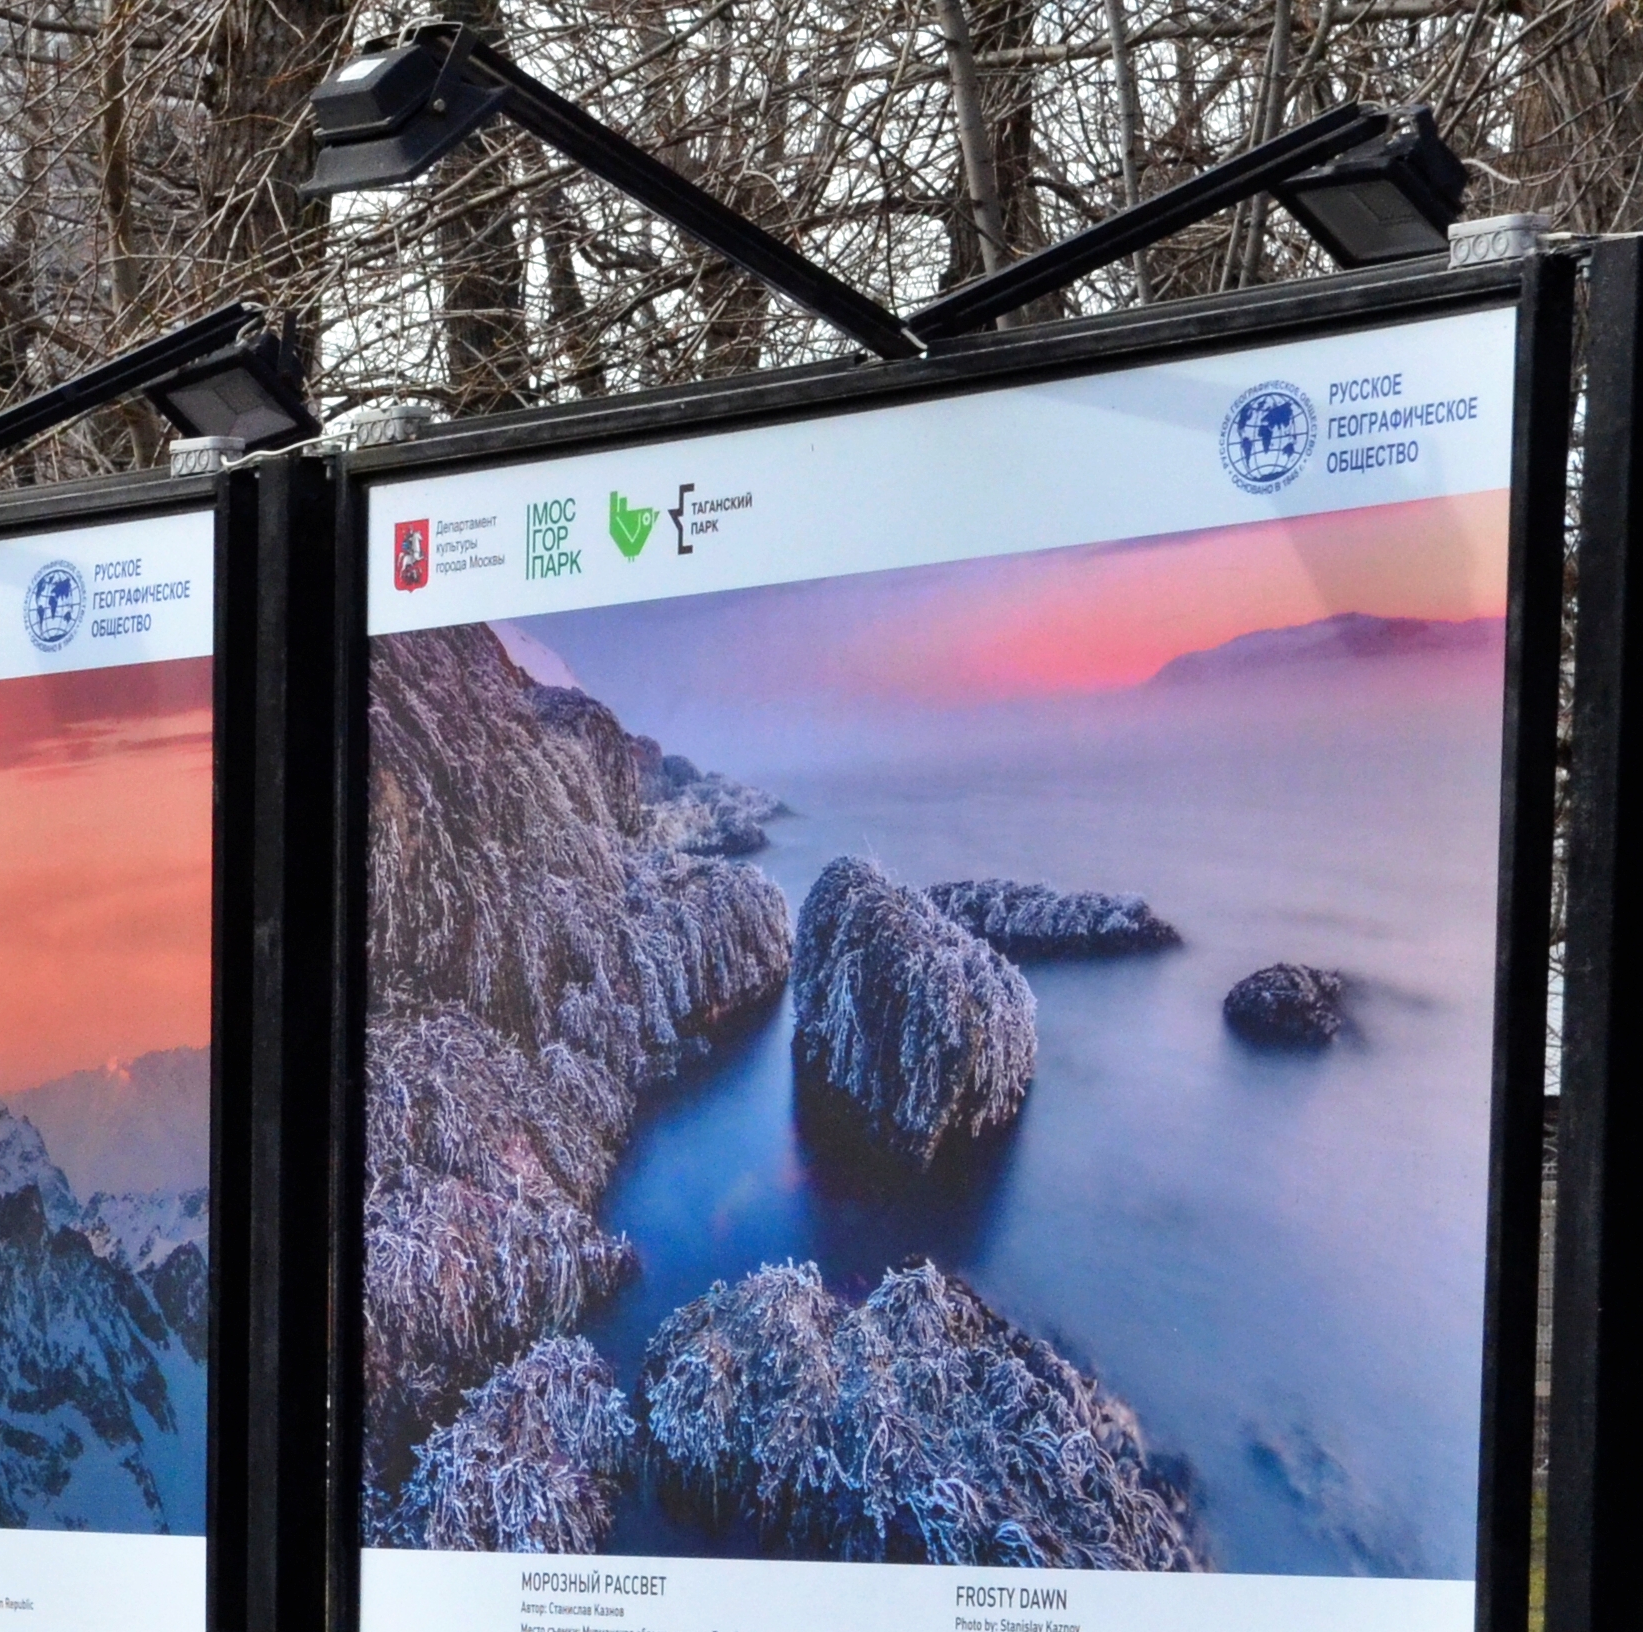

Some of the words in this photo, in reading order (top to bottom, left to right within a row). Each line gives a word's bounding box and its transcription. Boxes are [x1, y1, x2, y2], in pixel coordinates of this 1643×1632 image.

[1329, 373, 1403, 405] РУССКОЕ
[1327, 396, 1478, 440] ГЕОГРАФИЧЕСКОЕ
[1326, 440, 1419, 475] ОБЩЕСТВО
[532, 498, 576, 525] МОС
[691, 491, 754, 517] ТАГАНСКИЙ
[435, 514, 497, 535] Департамент
[690, 519, 719, 537] ПАРК
[435, 538, 478, 555] культуры
[532, 526, 570, 552] ГОР
[94, 558, 142, 583] РУССКОЕ
[435, 557, 468, 575] города
[469, 553, 506, 570] Москвы
[531, 549, 583, 580] ПАРК
[92, 579, 191, 611] ГЕОГРАФИЧЕСКОЕ
[91, 613, 152, 639] ОБЩЕСТВО
[521, 1570, 601, 1594] МОРОЗНЫЙ
[604, 1574, 667, 1596] РАССВЕТ
[520, 1601, 548, 1617] Автор:
[548, 1601, 592, 1616] Станислав
[594, 1604, 625, 1618] Казнов
[956, 1586, 1016, 1609] FROSTY
[1019, 1588, 1068, 1610] DAWN
[955, 1616, 983, 1632] Photo
